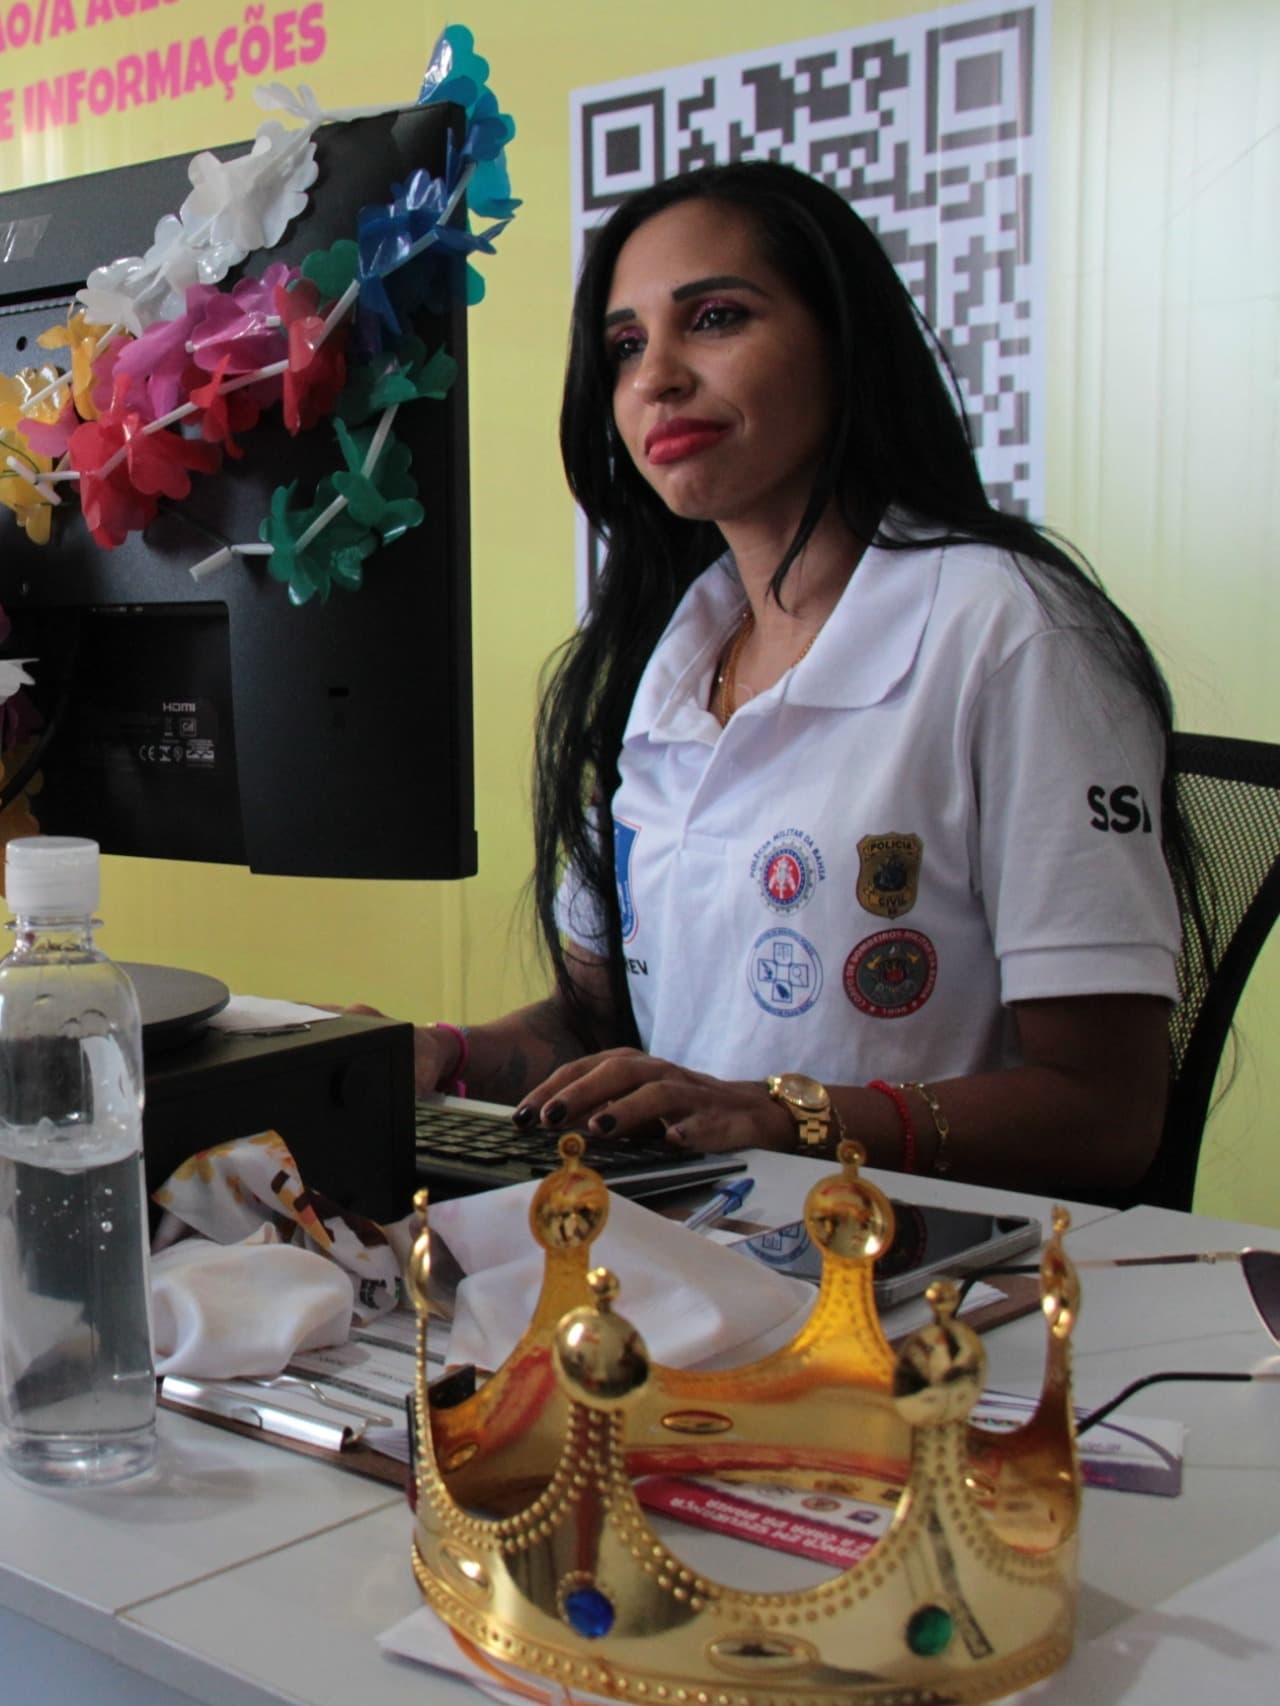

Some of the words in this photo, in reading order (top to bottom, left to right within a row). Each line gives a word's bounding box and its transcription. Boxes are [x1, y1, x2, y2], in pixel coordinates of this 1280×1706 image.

[23, 4, 328, 135] INFORMAÇÕES
[162, 702, 196, 712] HDMI
[812, 848, 825, 881] BAHIA
